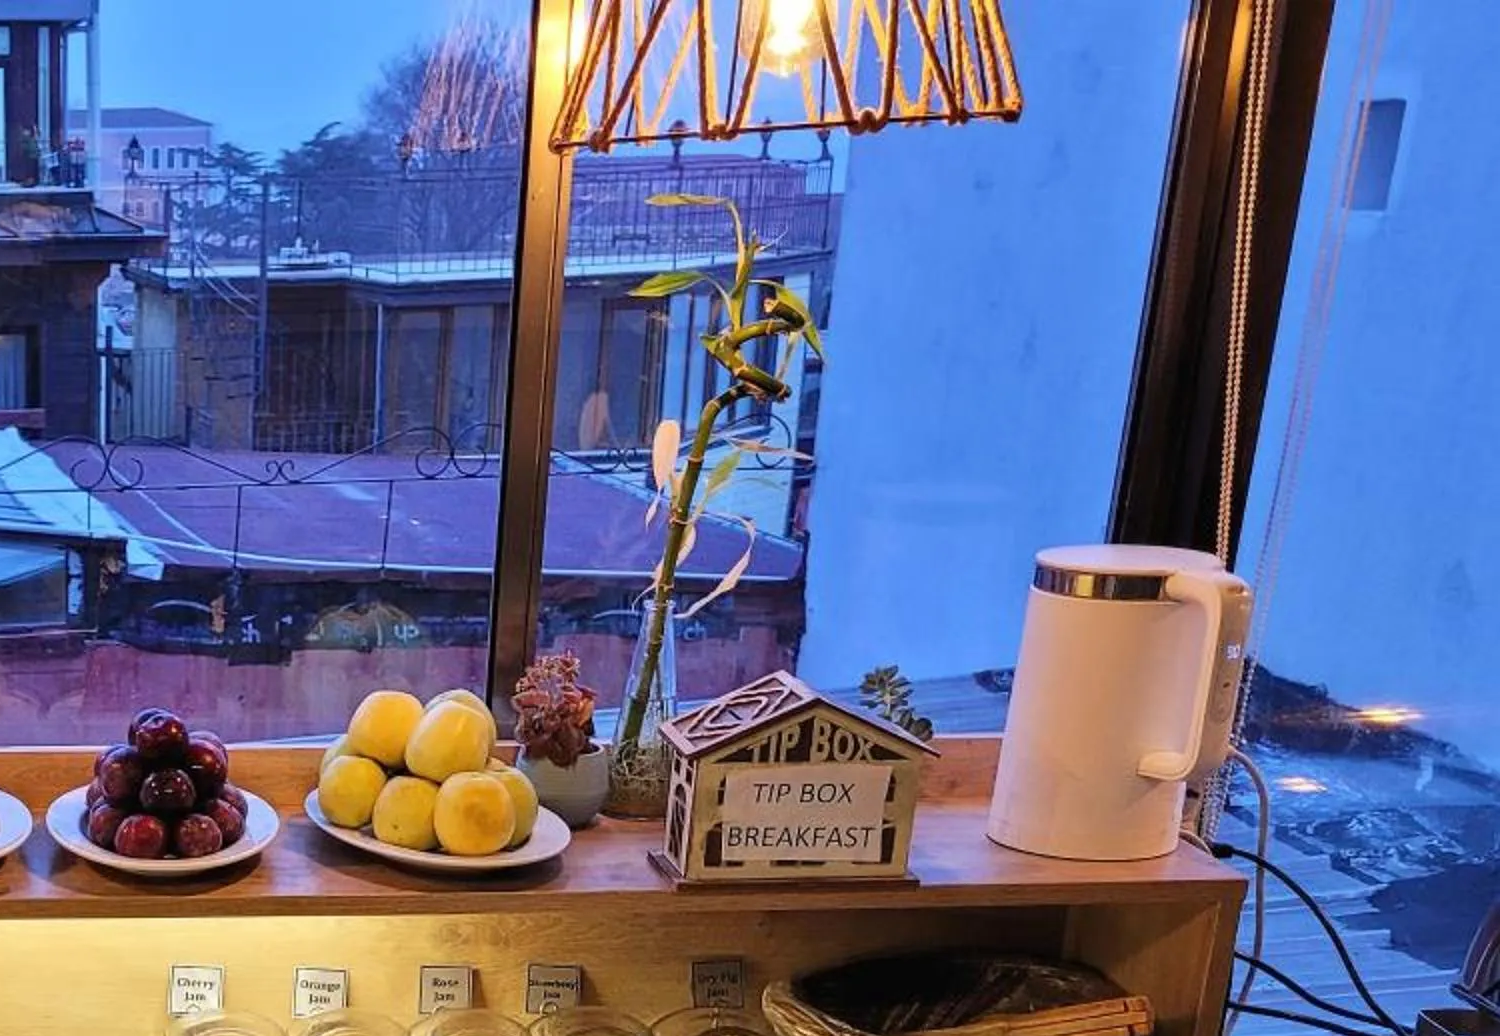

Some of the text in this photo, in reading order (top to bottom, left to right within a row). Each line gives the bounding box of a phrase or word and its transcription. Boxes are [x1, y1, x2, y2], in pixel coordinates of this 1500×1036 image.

[747, 717, 875, 762] TIP BOX
[754, 783, 855, 804] TIP BOX
[727, 826, 876, 848] BREAKFAST
[177, 977, 213, 990] Cherry
[300, 979, 341, 992] Orange
[432, 977, 459, 987] Rose
[184, 991, 206, 1001] Jam
[308, 993, 331, 1004] Jam
[434, 991, 455, 1003] Jam
